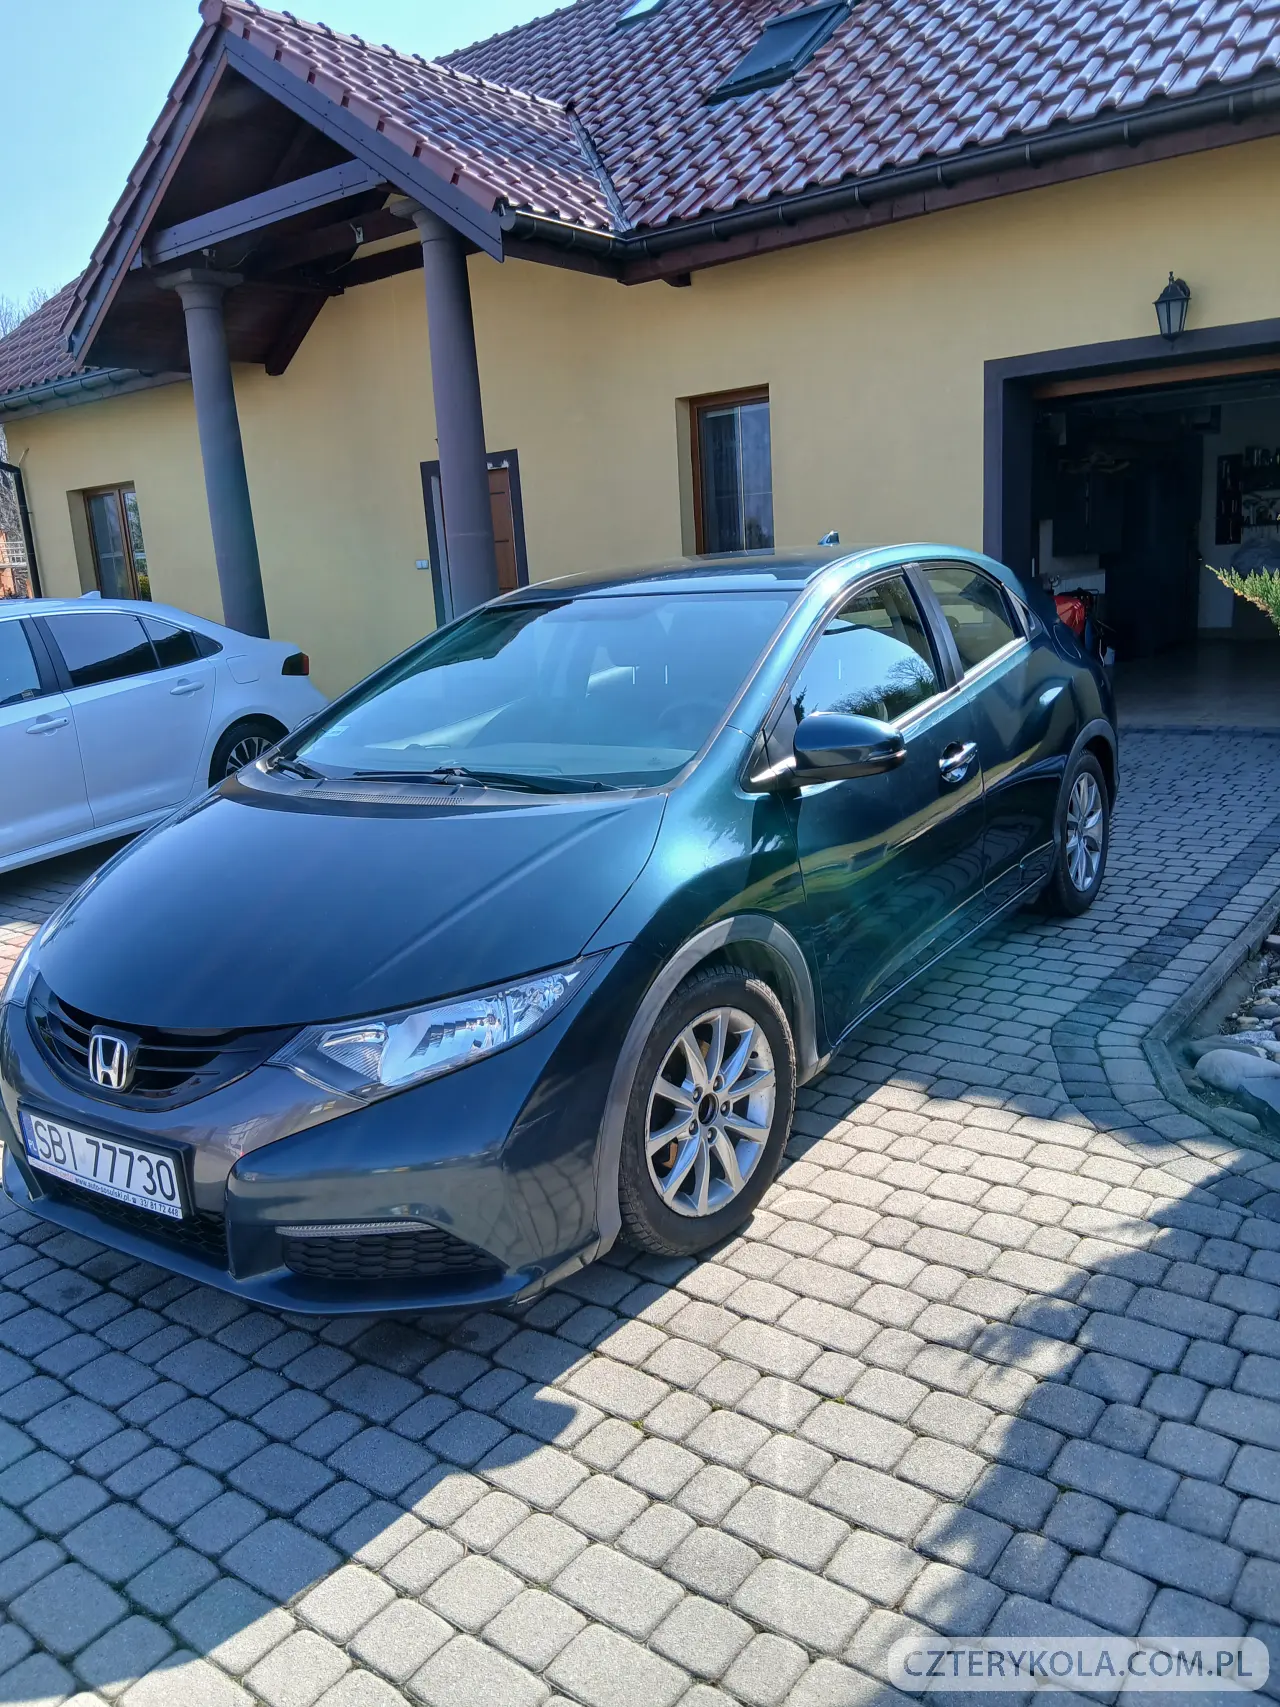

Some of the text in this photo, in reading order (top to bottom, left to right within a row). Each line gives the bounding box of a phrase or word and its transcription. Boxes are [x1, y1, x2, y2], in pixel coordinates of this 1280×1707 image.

[27, 1138, 38, 1153] PL
[34, 1120, 78, 1171] SBI
[85, 1137, 176, 1202] 77730
[167, 1206, 179, 1217] 448
